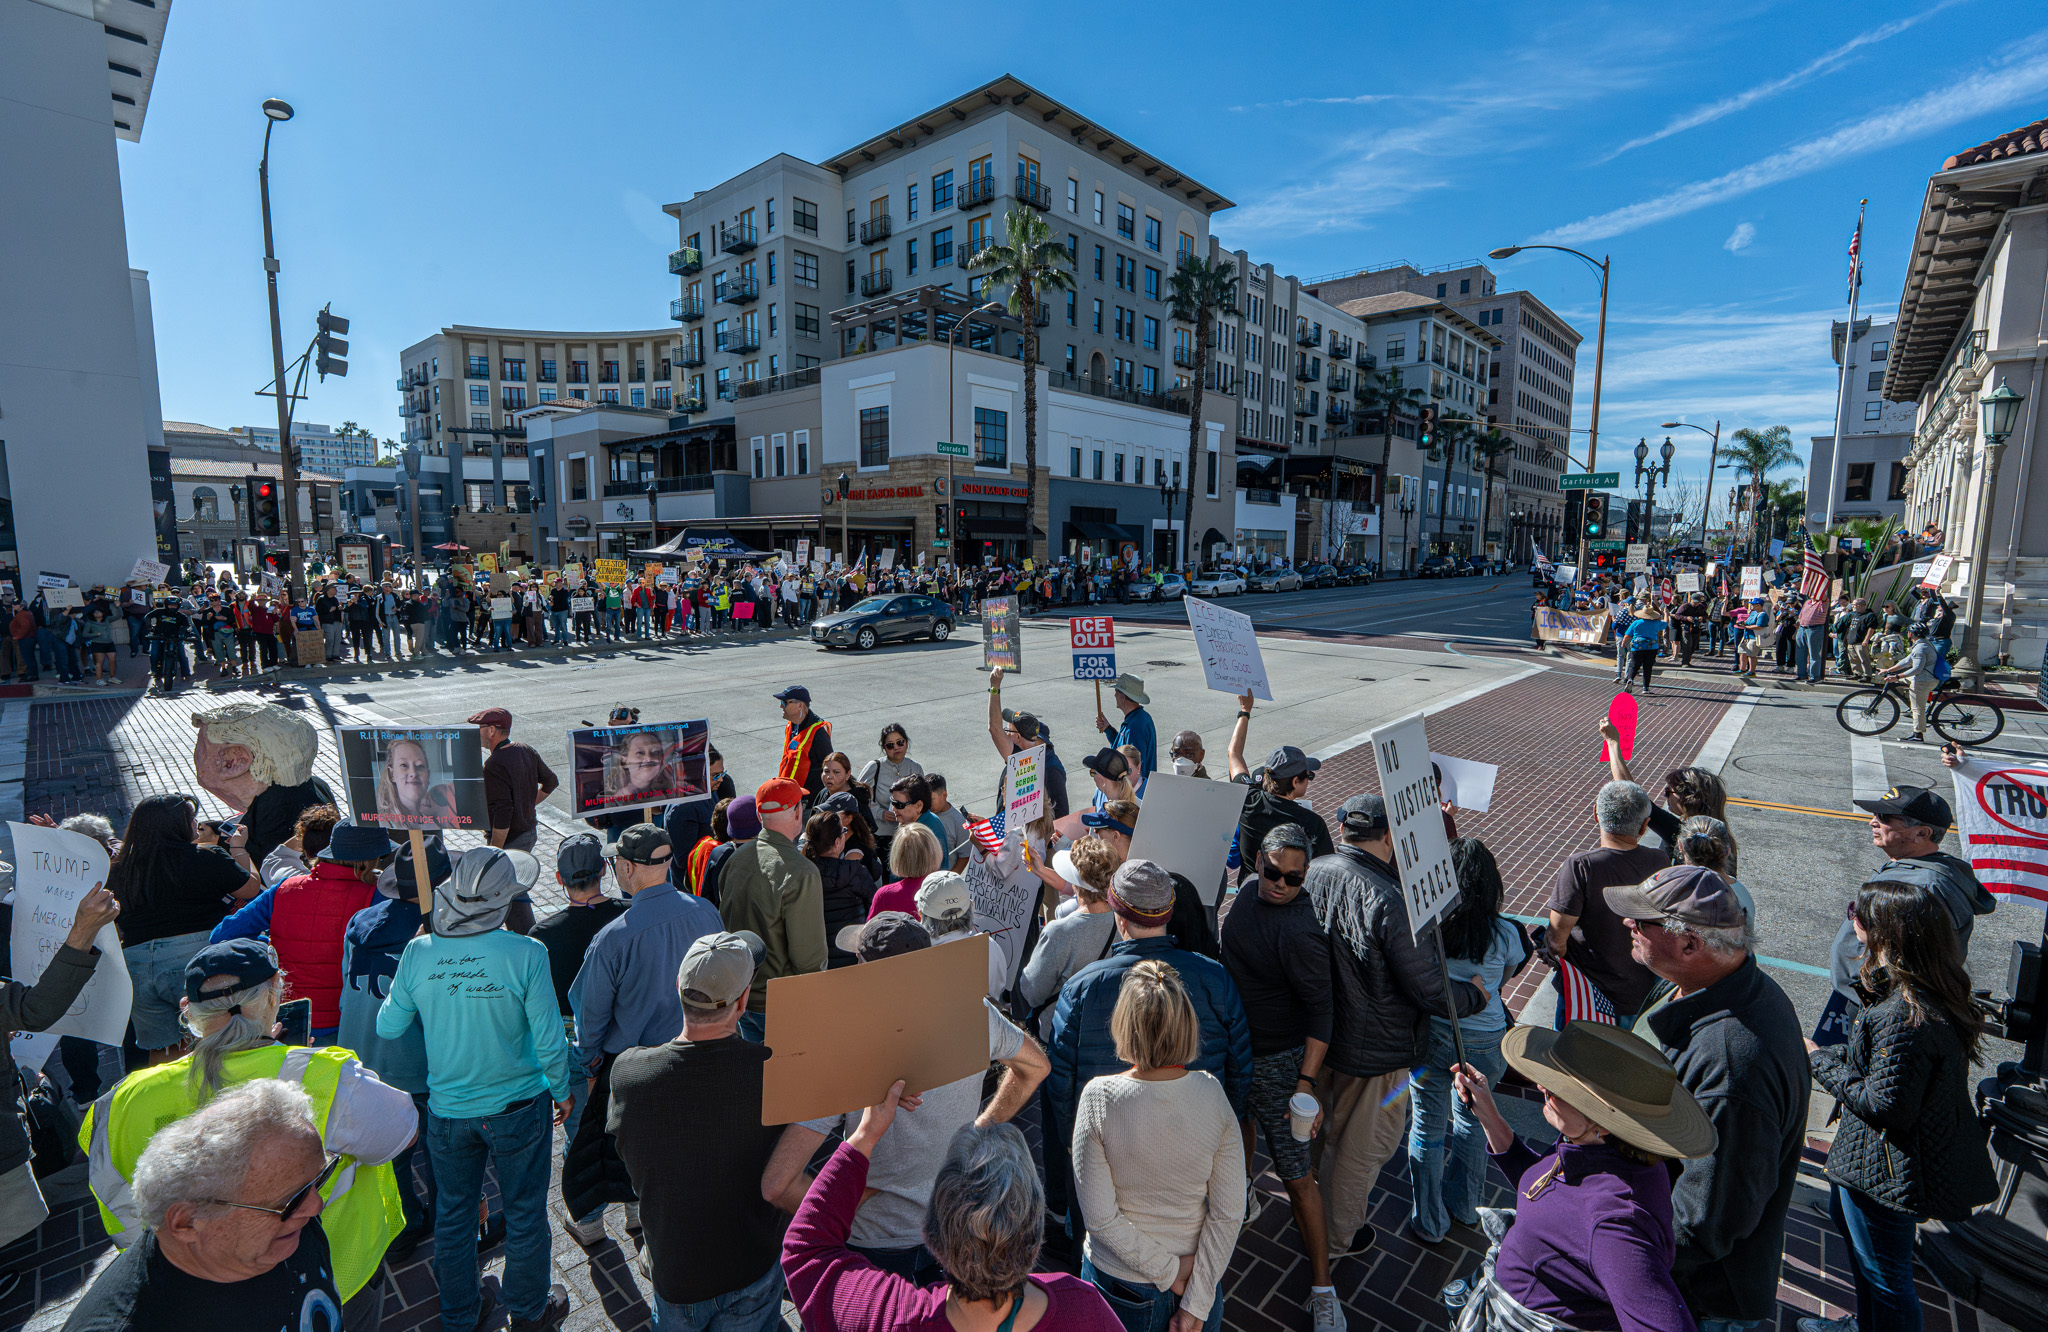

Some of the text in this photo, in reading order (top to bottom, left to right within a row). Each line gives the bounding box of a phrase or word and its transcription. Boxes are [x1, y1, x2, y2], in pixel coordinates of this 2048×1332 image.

[938, 444, 960, 454] Colorado
[1348, 464, 1364, 475] NOOR
[866, 488, 895, 499] KABOB
[896, 486, 924, 498] GRILL
[961, 484, 983, 494] NINI
[984, 485, 1010, 496] KABOB
[698, 540, 728, 550] Auto
[1935, 559, 1949, 568] ICE
[598, 567, 625, 575] KIDNAPPING
[1192, 602, 1251, 631] ICE AGENTS
[1540, 611, 1558, 628] ICE
[1000, 616, 1005, 634] A
[1076, 619, 1106, 632] ICE
[1073, 633, 1111, 646] OUT
[1202, 623, 1237, 642] DOMESTIC
[1208, 639, 1248, 656] TERRORISTS
[1079, 657, 1108, 667] FOR
[1232, 660, 1252, 673] GOOD
[1075, 667, 1114, 678] GOOD
[360, 732, 379, 740] R.I.P.
[436, 731, 460, 740] Good
[1019, 756, 1032, 767] WHY
[1382, 739, 1400, 774] NO
[1016, 763, 1036, 777] ALLOW
[1015, 774, 1037, 788] SCHOOL
[585, 794, 634, 806] MURDERED
[666, 785, 695, 795] 1/7/2026
[1011, 790, 1040, 810] BULLIES?
[1394, 774, 1438, 826] JUSTICE
[1986, 784, 2048, 819] TRU
[361, 813, 406, 822] MURDERED
[420, 815, 434, 824] ICE
[437, 816, 472, 824] 1/7/2026
[1401, 831, 1419, 870] NO
[33, 851, 90, 880] TRUMP
[967, 863, 1029, 901] HUNTING AND
[1412, 858, 1452, 916] PEACE
[965, 875, 1025, 915] PERSECUTING
[32, 904, 72, 929] AMERICA
[428, 968, 488, 980] are made
[447, 982, 504, 996] of water
